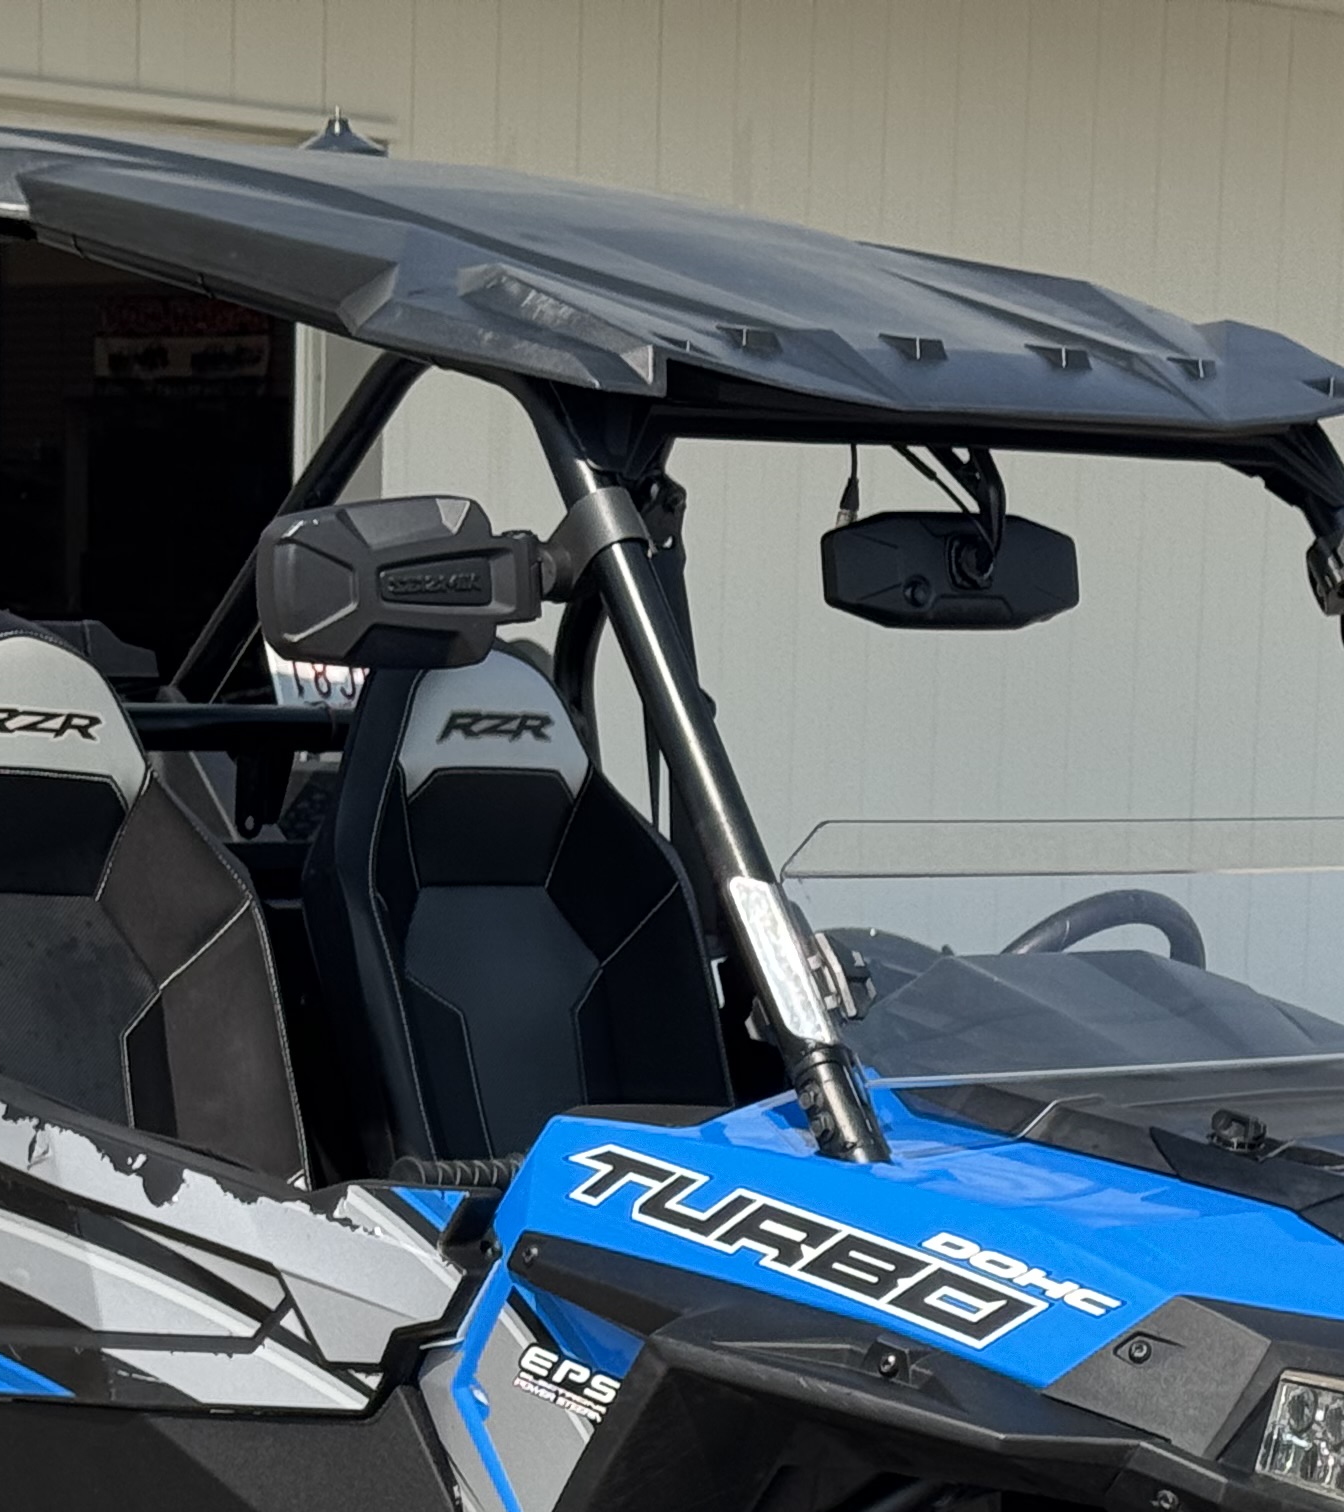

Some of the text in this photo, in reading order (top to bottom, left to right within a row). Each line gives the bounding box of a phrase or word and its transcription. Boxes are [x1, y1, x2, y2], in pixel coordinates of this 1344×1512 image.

[435, 710, 554, 744] RZR
[568, 1143, 1050, 1351] TURBO
[919, 1231, 1123, 1318] DOHC
[519, 1344, 622, 1405] EPS
